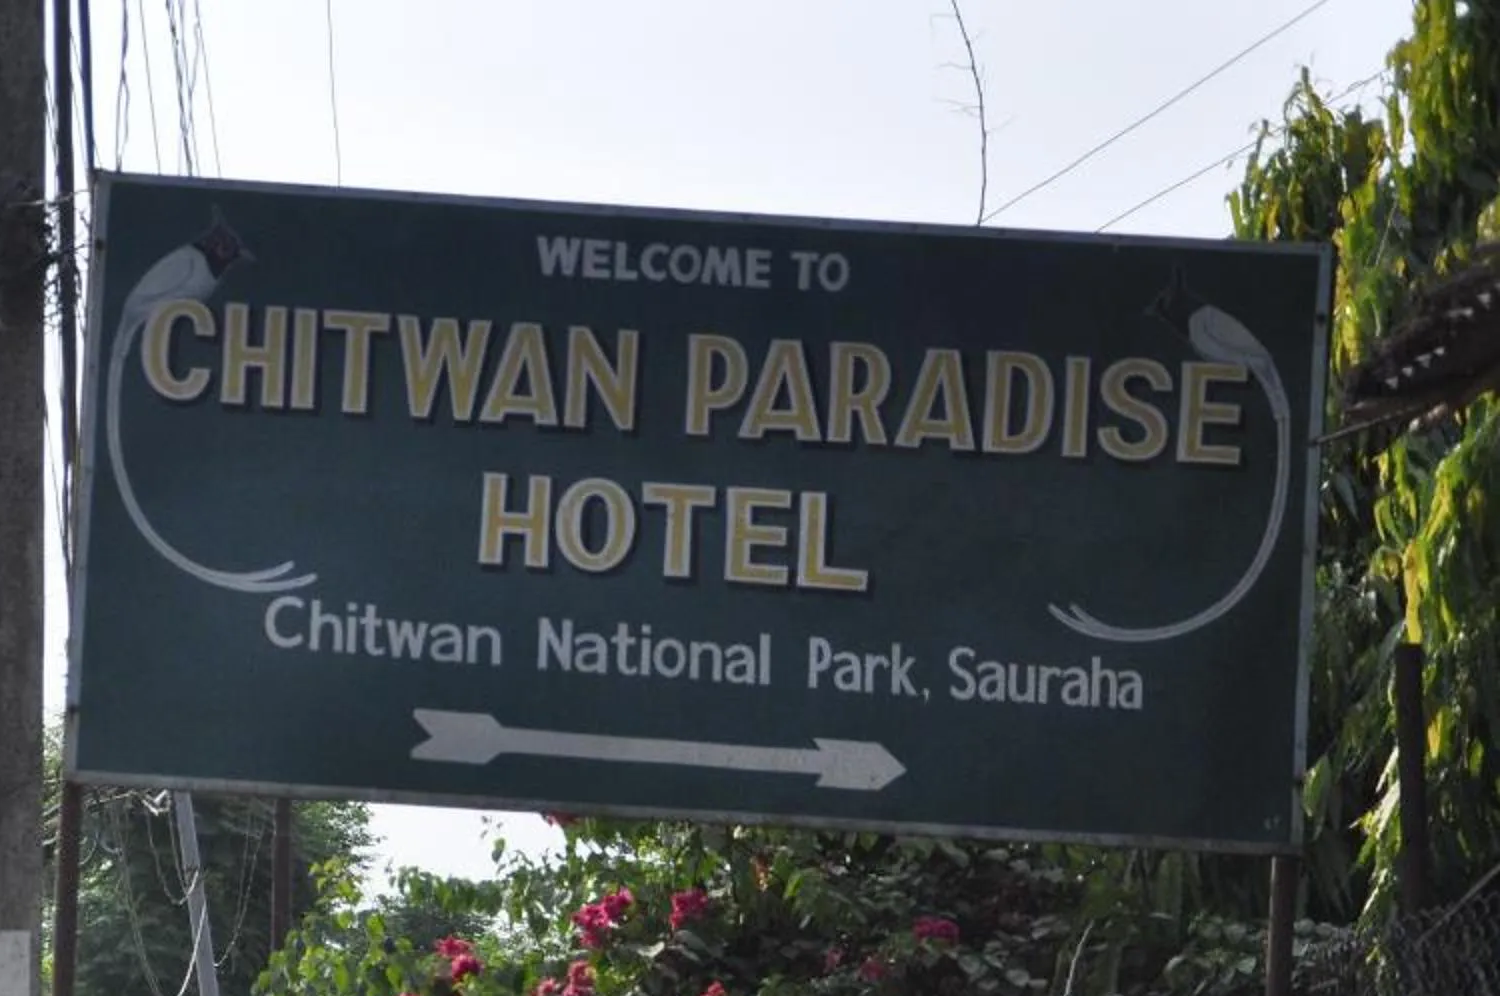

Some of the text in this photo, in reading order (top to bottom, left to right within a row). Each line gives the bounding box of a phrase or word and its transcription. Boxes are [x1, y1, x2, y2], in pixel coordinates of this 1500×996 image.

[536, 234, 850, 291] WELCOME TO
[140, 297, 1249, 466] CHITWAN PARADISE
[477, 471, 870, 593] HOTEL
[263, 595, 1145, 710] Chitwan National Park, Sauraha
